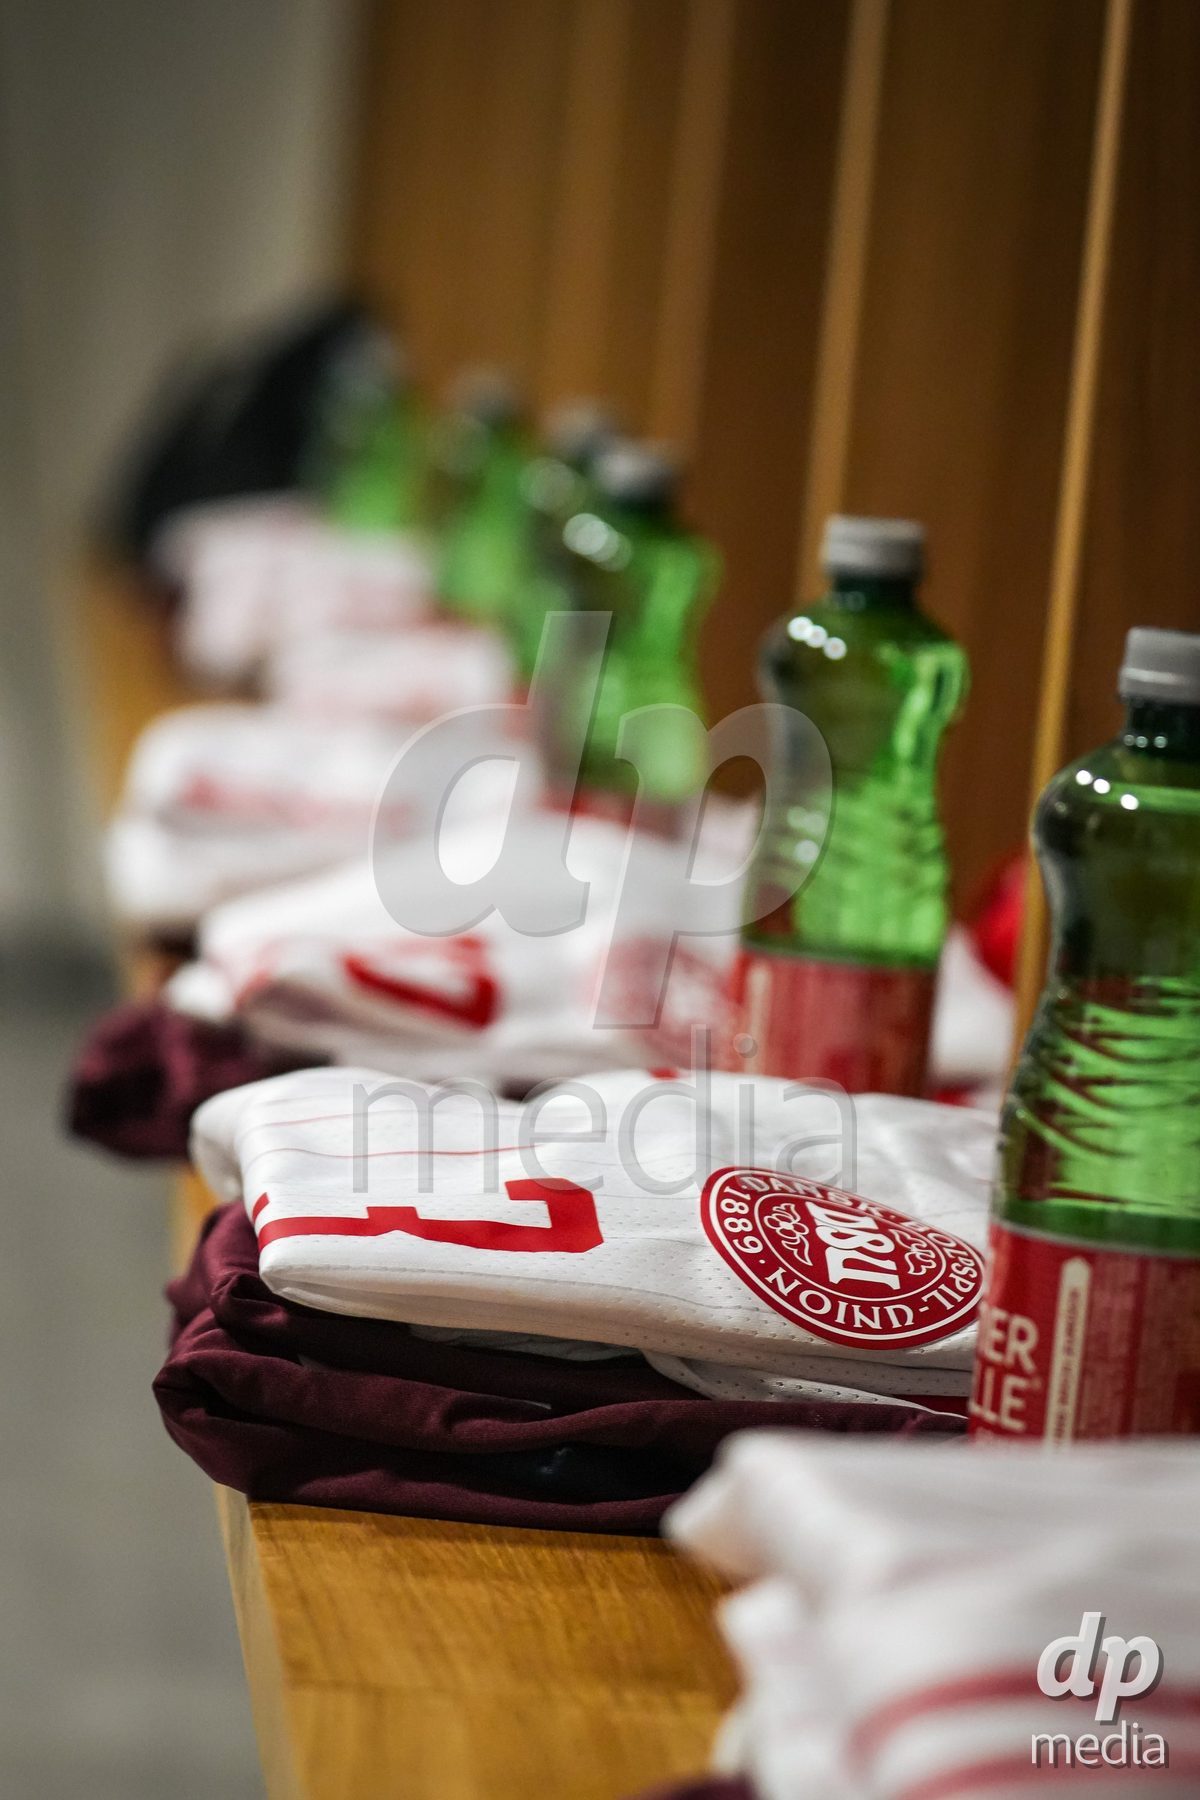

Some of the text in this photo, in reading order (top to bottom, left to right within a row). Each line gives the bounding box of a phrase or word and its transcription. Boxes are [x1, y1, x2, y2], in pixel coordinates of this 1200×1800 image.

[719, 1185, 764, 1255] 1889
[804, 1200, 901, 1291] DBU
[979, 1301, 1040, 1373] ER
